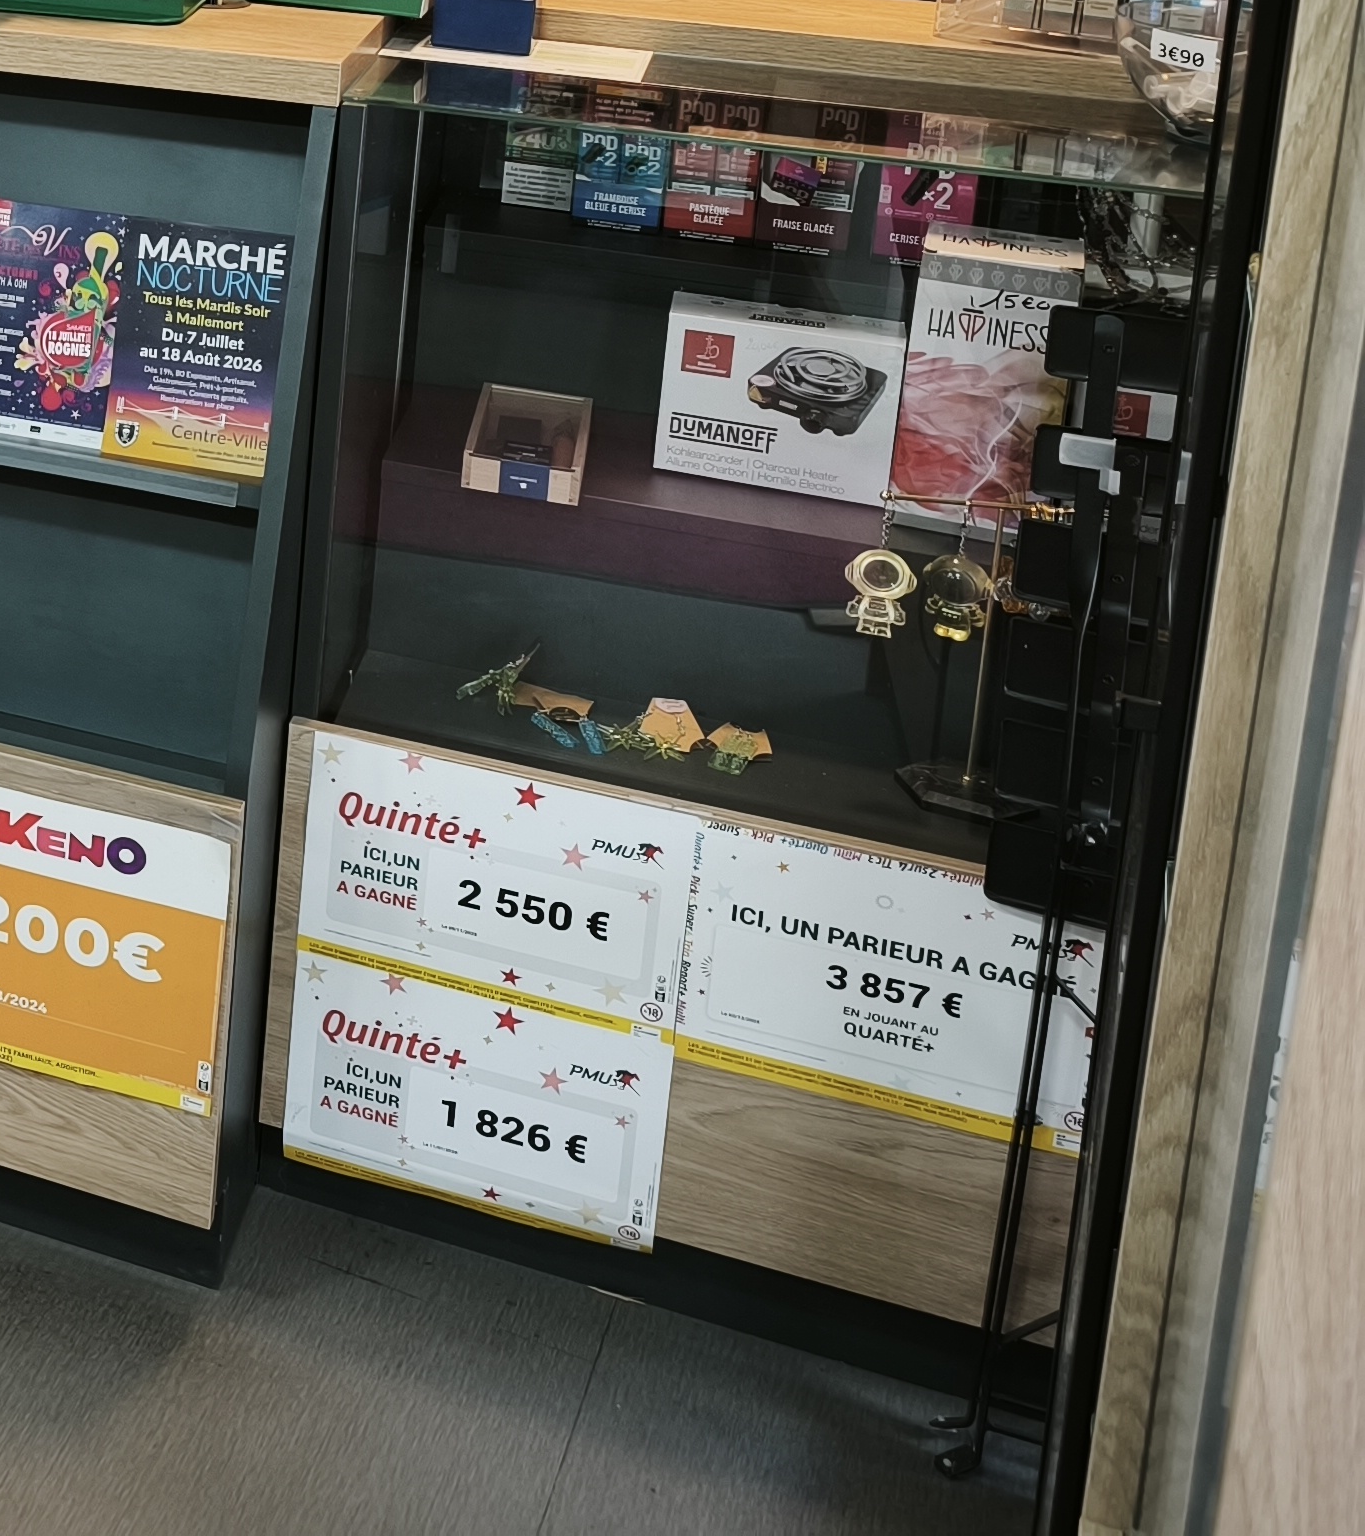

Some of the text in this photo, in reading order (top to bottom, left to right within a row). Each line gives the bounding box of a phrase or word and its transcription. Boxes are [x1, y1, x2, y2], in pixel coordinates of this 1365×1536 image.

[1158, 43, 1204, 66] 3€90
[773, 217, 835, 235] FRAISE GLACÉE
[138, 234, 286, 275] MARCHÉ
[137, 260, 283, 303] NOCTURNE
[143, 291, 271, 318] Tous les Mardis Soir
[165, 313, 244, 331] à Mallemort
[48, 342, 91, 357] ROGNES
[162, 328, 245, 351] Du 7 Juillet
[139, 348, 263, 372] au 18 Août 2026
[172, 425, 267, 451] Centre-Ville
[752, 459, 800, 479] Charcoal
[803, 468, 839, 483] Heater
[338, 792, 487, 849] Quinté+
[340, 860, 419, 891] PARIEUR
[457, 879, 610, 942] 2 550 €
[321, 1009, 467, 1071] Quinté+
[844, 1022, 935, 1054] QUARTÉ+
[323, 1076, 400, 1109] PARIEUR
